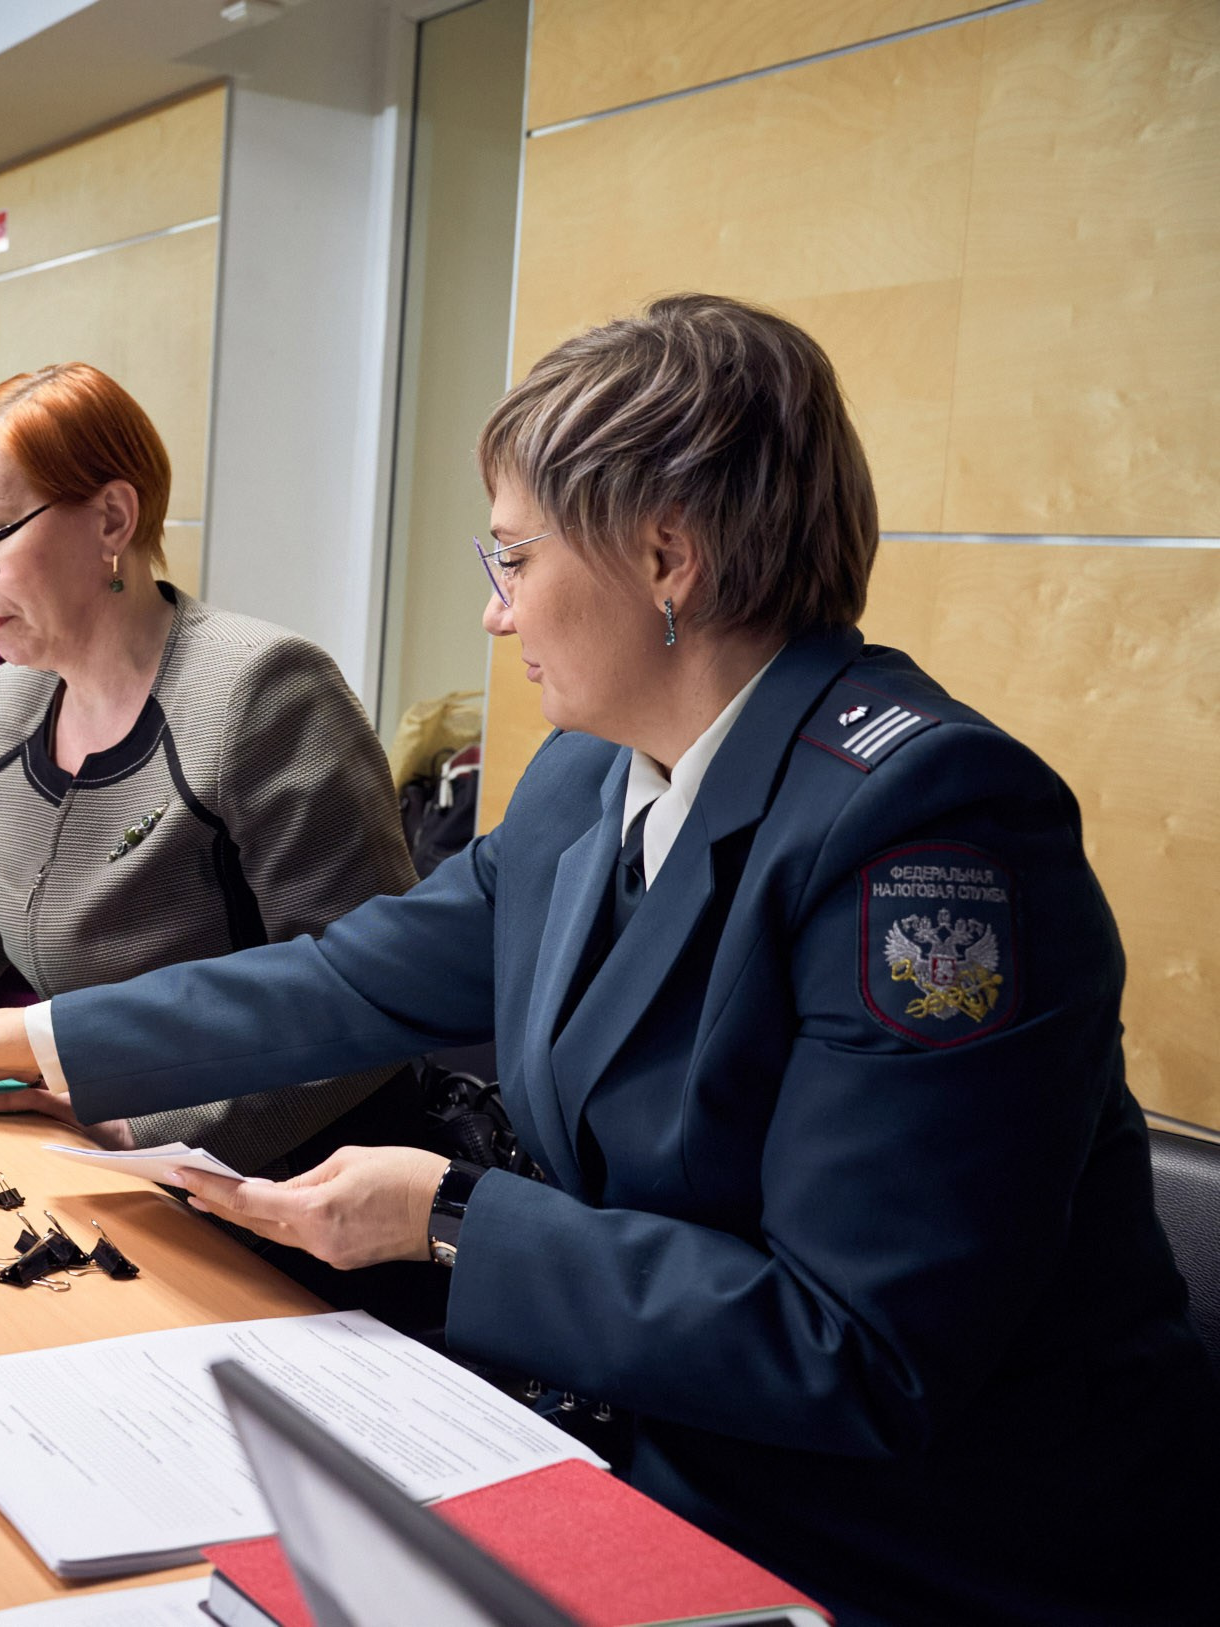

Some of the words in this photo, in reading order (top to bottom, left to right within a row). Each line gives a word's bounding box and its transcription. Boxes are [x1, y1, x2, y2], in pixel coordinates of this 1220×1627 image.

[890, 866, 994, 884] ФЕДЕРАЛЬНАЯ
[873, 883, 955, 899] НАЛОГОВАЯ
[957, 886, 1008, 903] СЛУЖБА
